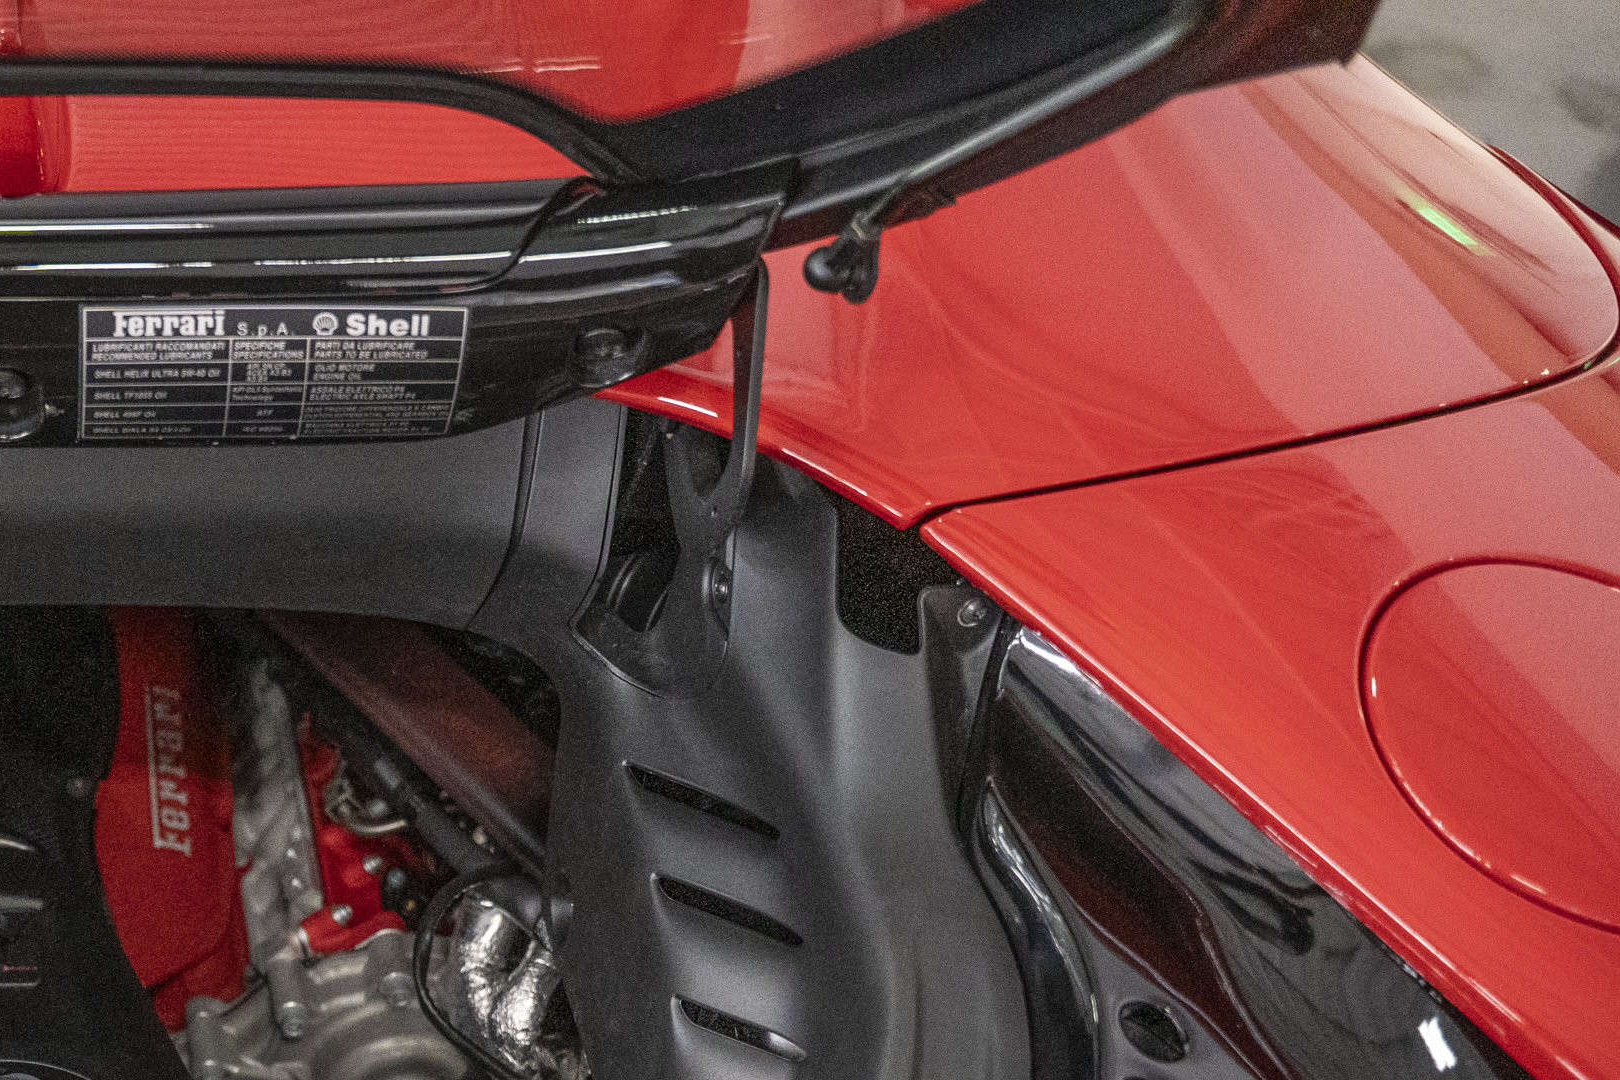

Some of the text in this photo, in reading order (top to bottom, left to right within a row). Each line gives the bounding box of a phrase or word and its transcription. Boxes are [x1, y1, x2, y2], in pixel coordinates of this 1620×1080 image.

[113, 310, 225, 337] Ferrari
[346, 313, 430, 337] Shell
[92, 342, 226, 352] LUBRIFICANTI RACCOMANDATI
[234, 341, 286, 351] SPECIFICHE
[314, 342, 415, 350] PARTI DA LUBRIFICARE
[91, 352, 213, 361] RECOMMENDED LUBRICANTS
[232, 350, 304, 359] SPECIFICATIONS
[314, 351, 428, 360] PARTS TO BE LUBRICATED
[314, 364, 376, 372] OLIO MOTORE
[94, 370, 122, 379] SHELL
[151, 369, 180, 378] ULTRA
[312, 372, 346, 381] ENGINE
[93, 391, 121, 400] SHELL
[145, 684, 192, 857] Ferrari
